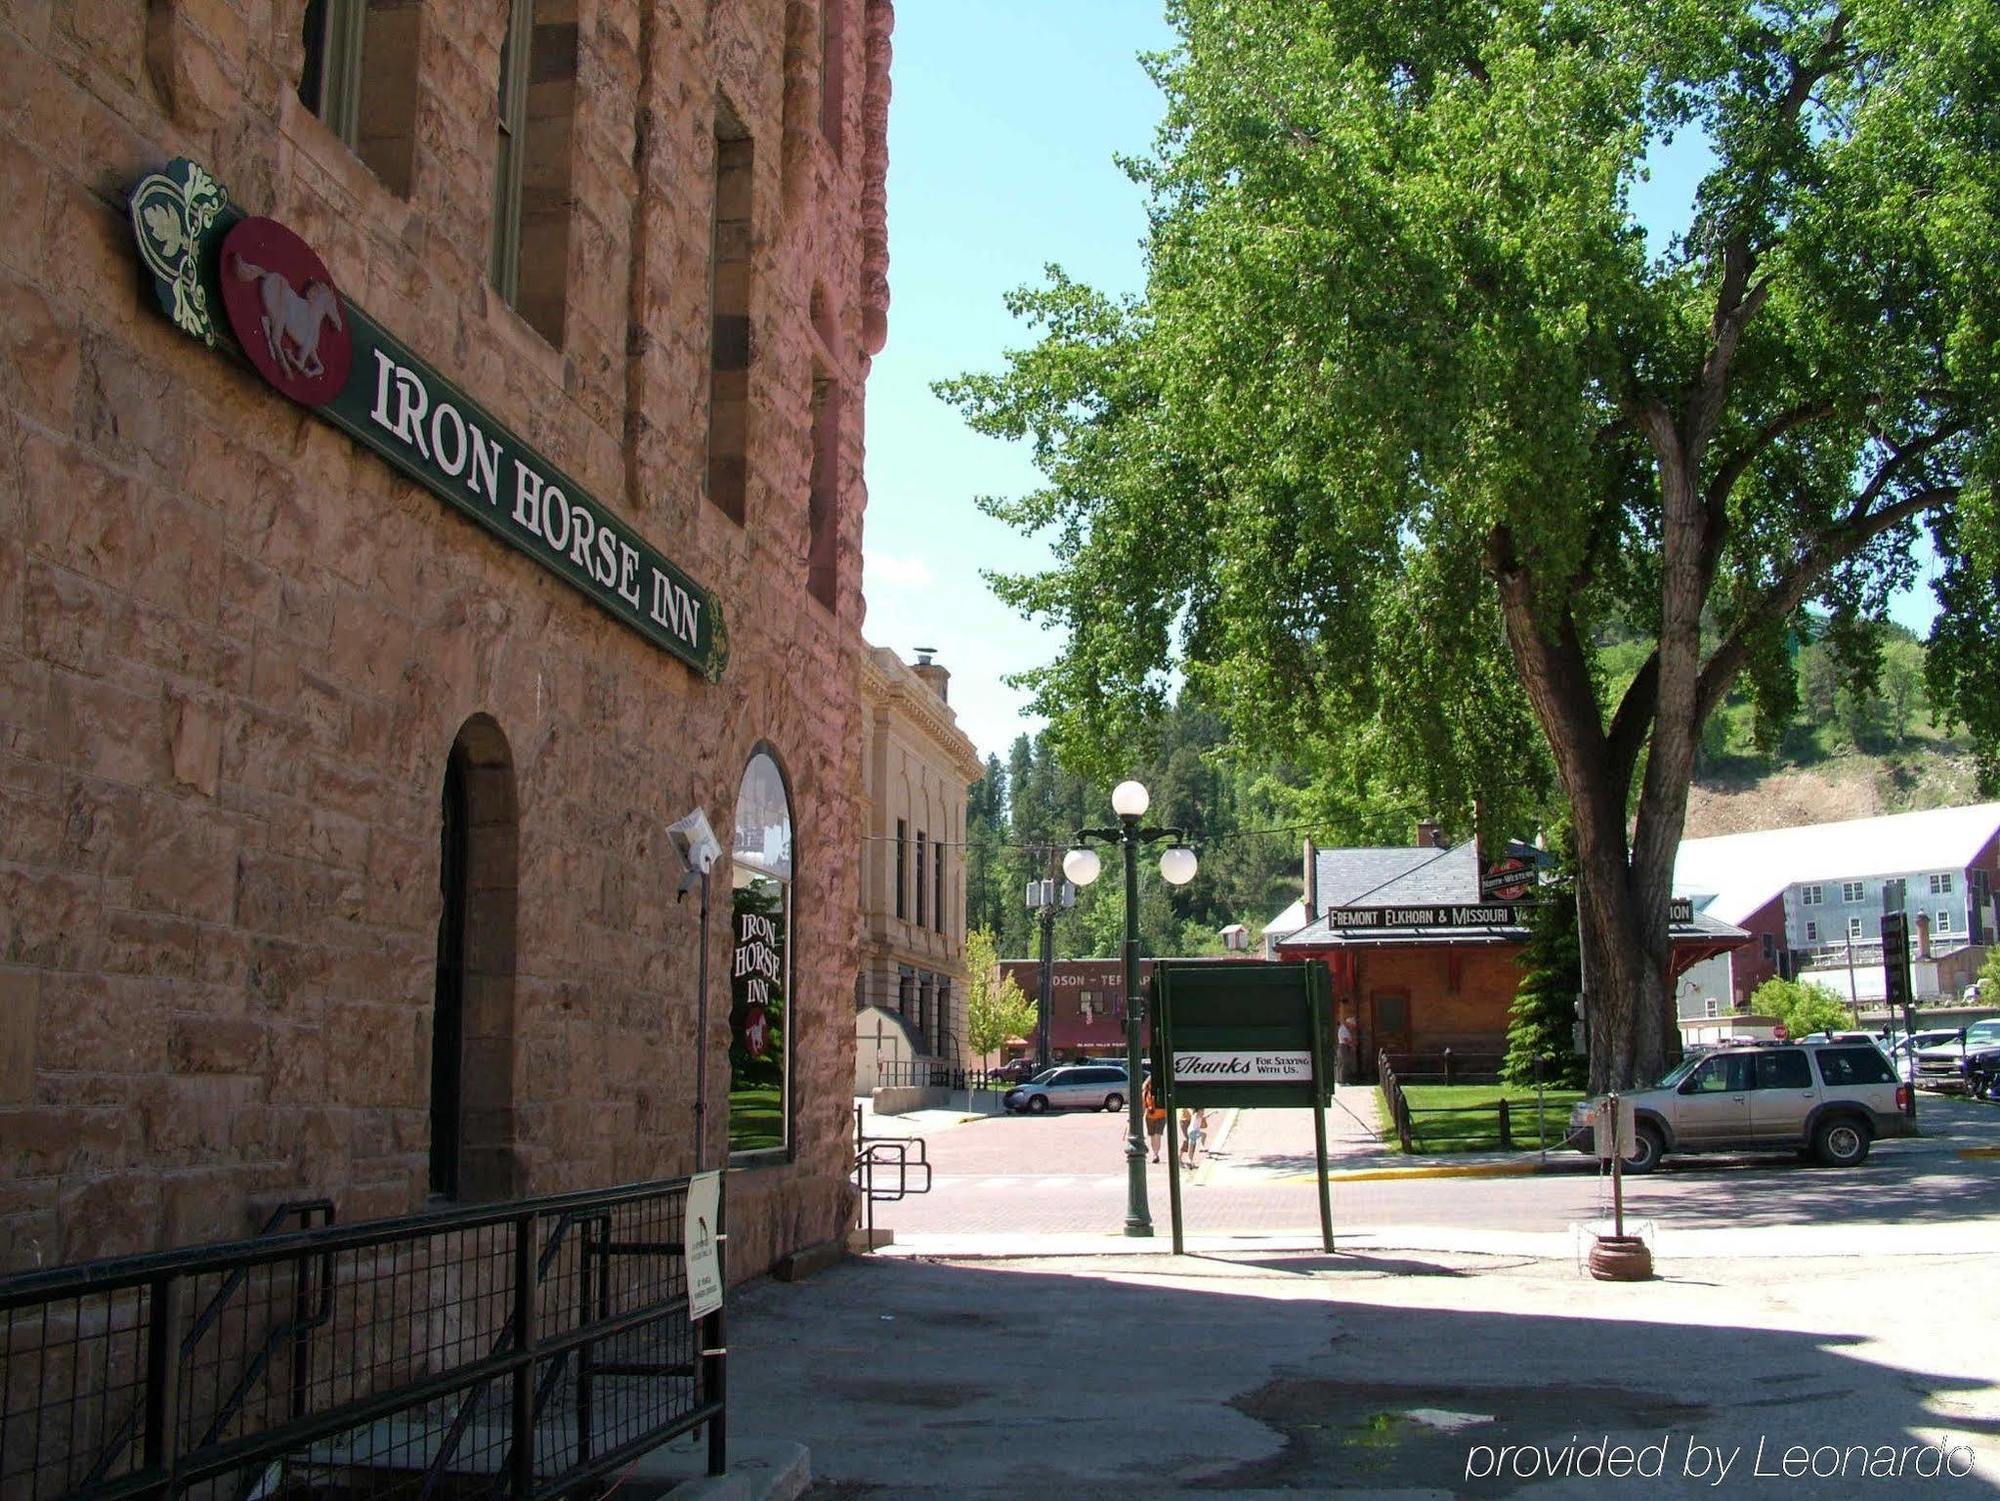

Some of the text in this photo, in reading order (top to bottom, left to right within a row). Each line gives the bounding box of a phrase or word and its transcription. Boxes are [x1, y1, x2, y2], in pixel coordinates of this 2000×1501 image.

[371, 349, 701, 648] IRON HORSE INN
[741, 914, 776, 948] IRON
[1331, 910, 1378, 927] FREMONT
[1385, 910, 1433, 926] ELKHORN
[1438, 910, 1447, 922] &
[1453, 907, 1508, 925] MISSOURI
[735, 942, 781, 987] HORSE
[747, 979, 769, 1005] INN
[1175, 1056, 1251, 1074] Thanks
